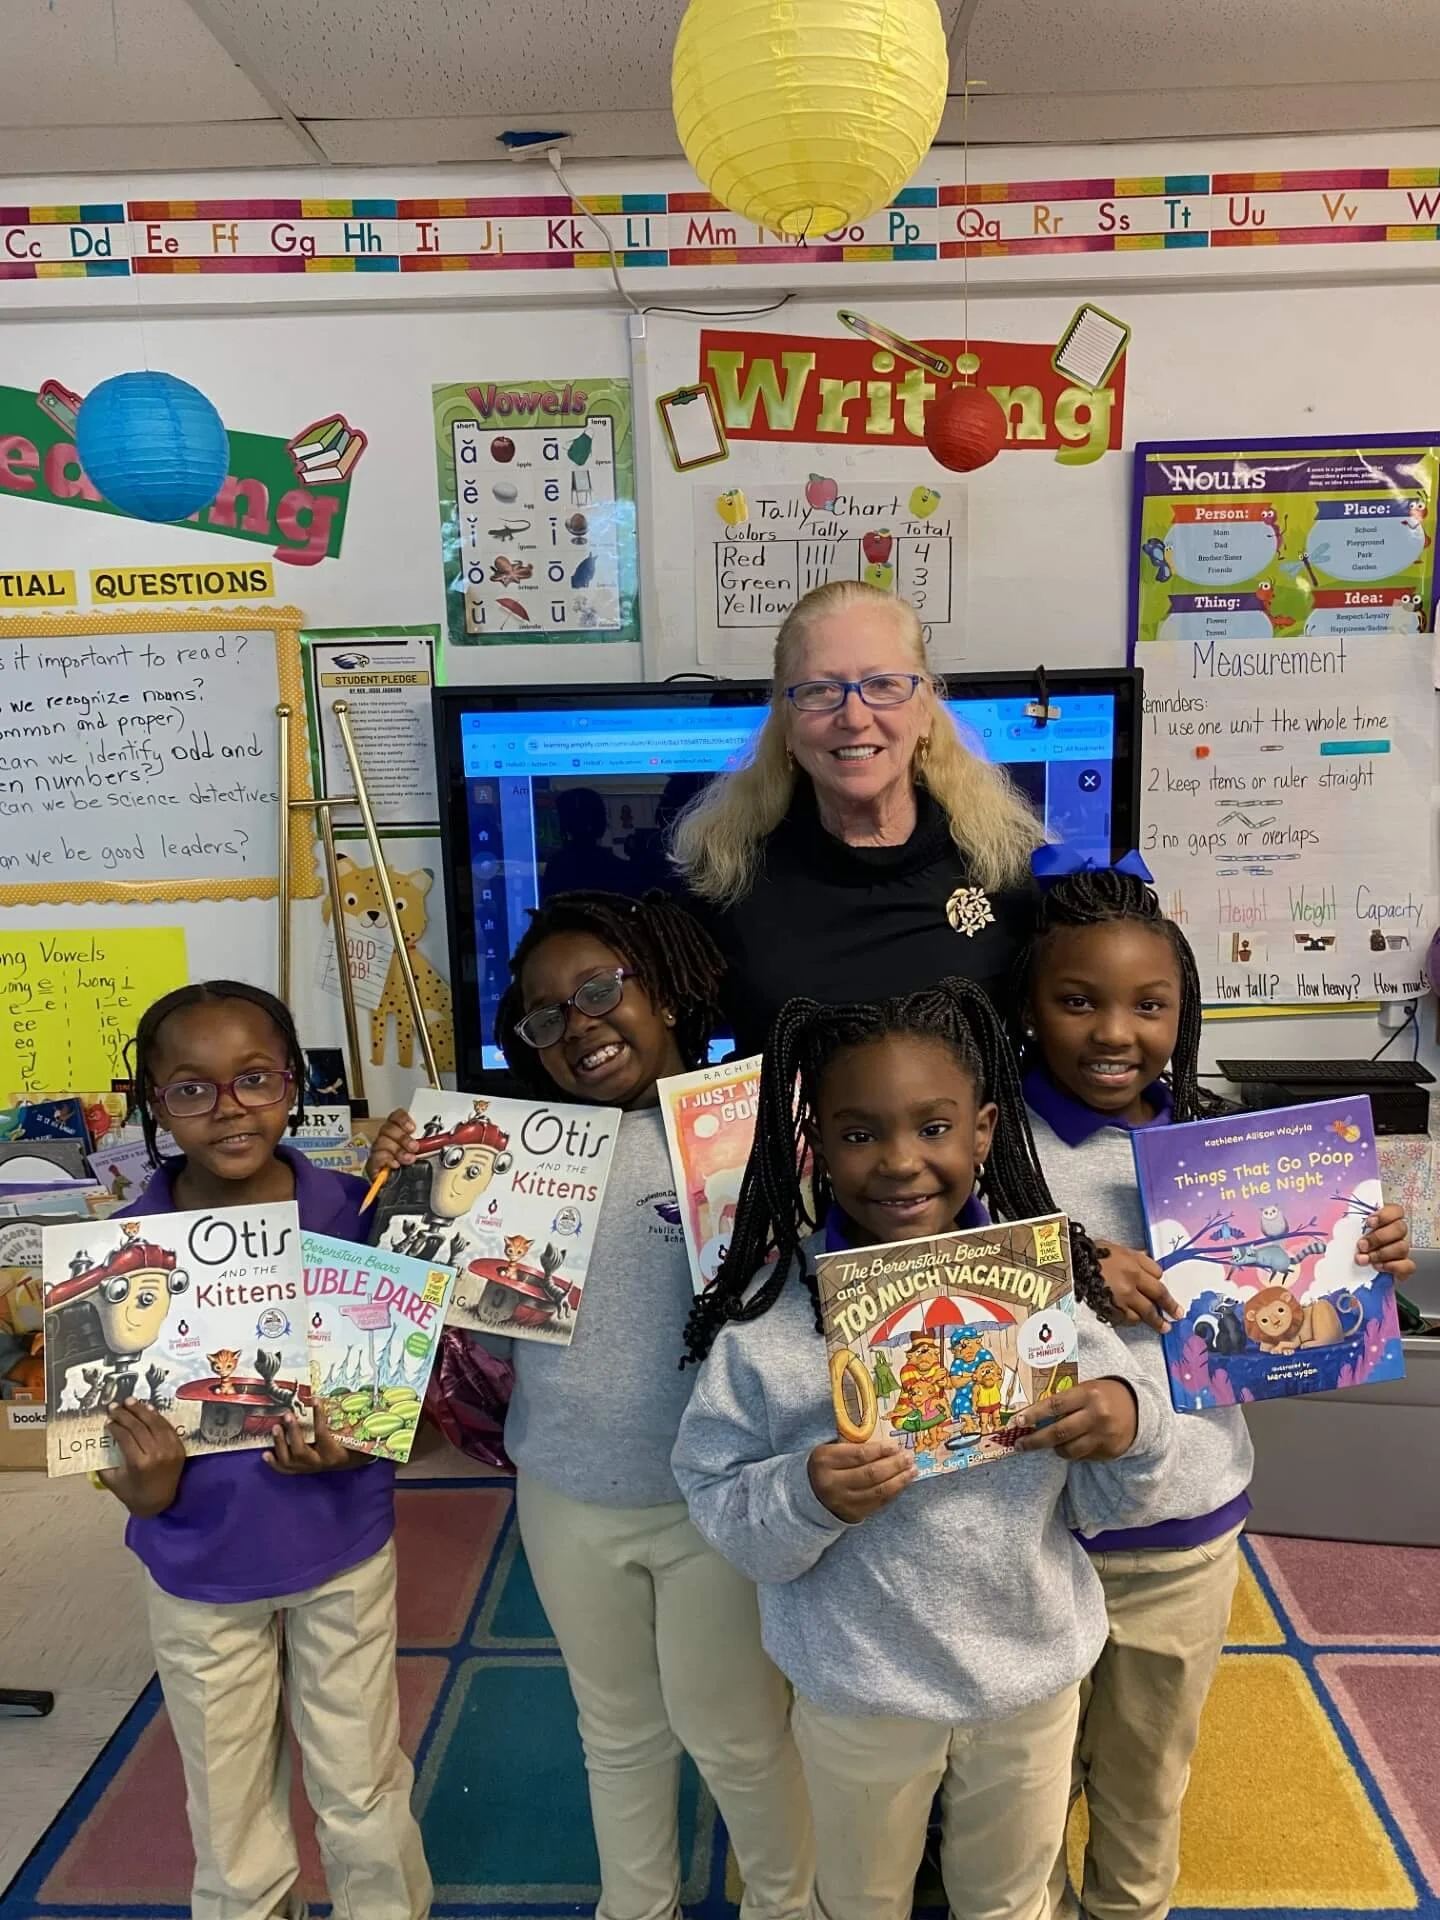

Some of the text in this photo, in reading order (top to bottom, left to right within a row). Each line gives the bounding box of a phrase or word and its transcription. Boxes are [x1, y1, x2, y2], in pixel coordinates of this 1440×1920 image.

[5, 229, 41, 258] Cc
[70, 227, 112, 256] Dd
[146, 224, 179, 254] Ee
[213, 223, 239, 253] Ff
[271, 223, 316, 256] Gg
[344, 223, 382, 252] Hh
[416, 223, 439, 252] Ii
[481, 221, 504, 257] Jj
[547, 220, 584, 249] Kk
[687, 217, 736, 245] Mm
[889, 212, 920, 244] Pp
[957, 208, 1000, 240] Qq
[1033, 206, 1064, 234] Rr
[1098, 202, 1130, 232] Ss
[1164, 199, 1191, 229] Tt
[1229, 197, 1265, 227] Uu
[1321, 193, 1358, 223] Vv
[465, 384, 588, 419] Vowels
[1172, 464, 1266, 492] Nouns
[756, 495, 902, 530] Tally Chart
[1195, 502, 1391, 521] Person: Place:
[725, 519, 951, 542] Colors Tally Total
[723, 544, 930, 567] Red 4
[95, 570, 268, 597] QUESTIONS
[721, 568, 928, 591] Green 3
[724, 593, 794, 614] Yellow
[1194, 592, 1384, 611] Thing: Idea:
[14, 636, 248, 678] it important to read?
[1193, 638, 1347, 678] Measurement
[335, 674, 417, 685] STUDENT PLEDGE
[10, 678, 204, 715] we recognize nouns?
[78, 712, 107, 732] and
[119, 706, 185, 735] proper)
[1168, 705, 1389, 735] use one unit the whole time
[48, 752, 77, 766] we
[89, 739, 164, 776] identify
[222, 732, 263, 758] and
[35, 762, 153, 793] numbers?
[1167, 761, 1375, 796] keep items or ruler straight
[42, 782, 280, 811] we be science detectives
[26, 830, 249, 870] we be good leaders?
[1162, 824, 1320, 857] no gaps or overlaps
[1219, 884, 1423, 928] Height Weight Capacity
[40, 936, 105, 963] Vowels
[348, 940, 376, 960] OOD
[77, 967, 116, 999] Long
[1216, 974, 1280, 999] How tall?
[1297, 973, 1361, 1000] How heavy?
[1373, 972, 1398, 994] How
[13, 1019, 37, 1033] ee
[100, 1011, 119, 1028] ie
[15, 1037, 34, 1049] ea
[693, 1084, 737, 1108] JUST
[520, 1108, 609, 1158] Otis
[1204, 1135, 1244, 1148] Kathleen
[1246, 1129, 1275, 1141] Allison
[537, 1162, 588, 1175] AND THE
[1174, 1152, 1354, 1190] Things That Go Poop
[511, 1171, 598, 1202] Kittens
[1220, 1171, 1324, 1200] in the Night
[188, 1215, 292, 1266] Otis
[1040, 1240, 1057, 1249] FIRST
[1040, 1247, 1057, 1256] TIME
[219, 1264, 278, 1279] AND THE
[305, 1253, 323, 1266] the
[364, 1255, 400, 1275] Bears
[837, 1243, 1001, 1283] The Berenstain Bears
[1039, 1253, 1060, 1264] BOOKS
[195, 1280, 297, 1309] Kittens
[372, 1276, 437, 1331] DARE
[833, 1265, 1054, 1343] TOO MUCH VACATION
[836, 1282, 867, 1301] and
[1036, 1347, 1065, 1359] MINUTES
[13, 1412, 48, 1423] books
